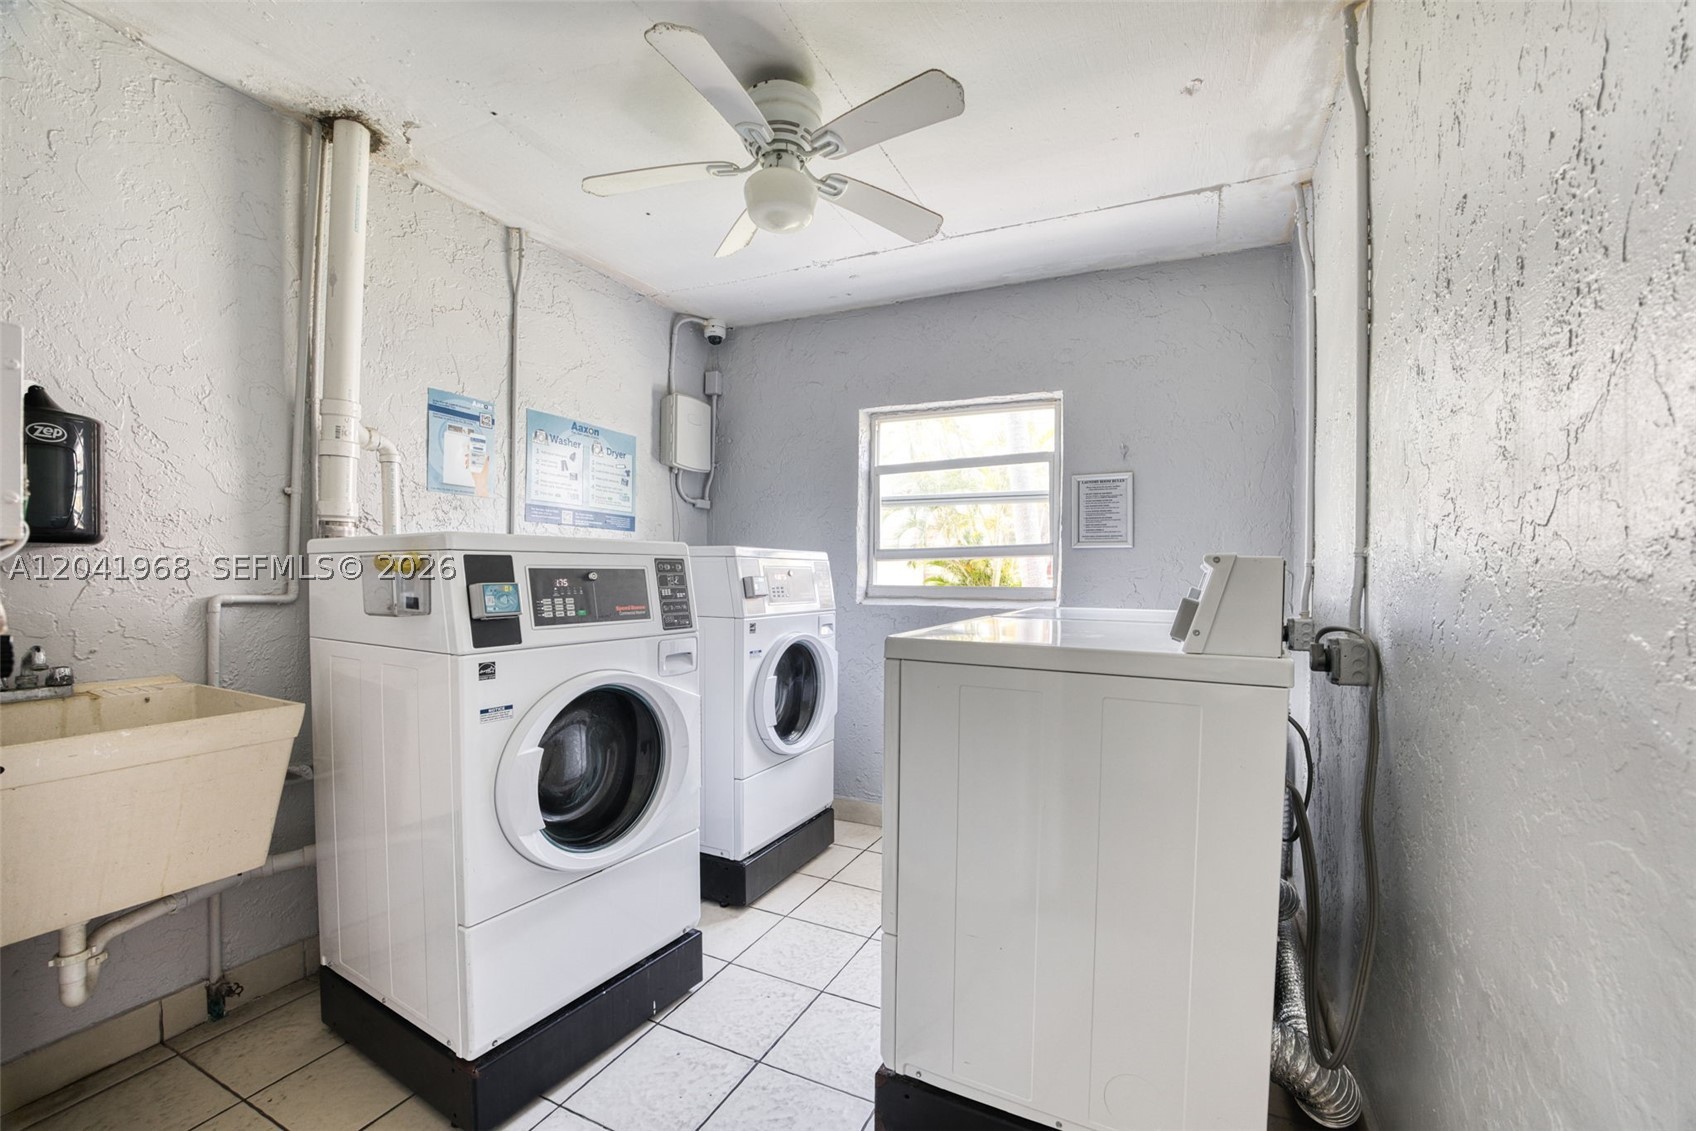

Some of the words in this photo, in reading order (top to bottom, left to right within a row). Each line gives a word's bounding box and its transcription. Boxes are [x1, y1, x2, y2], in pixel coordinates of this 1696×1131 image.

[571, 421, 600, 437] Aaxon
[549, 433, 582, 449] Washer
[606, 447, 626, 460] Dryer
